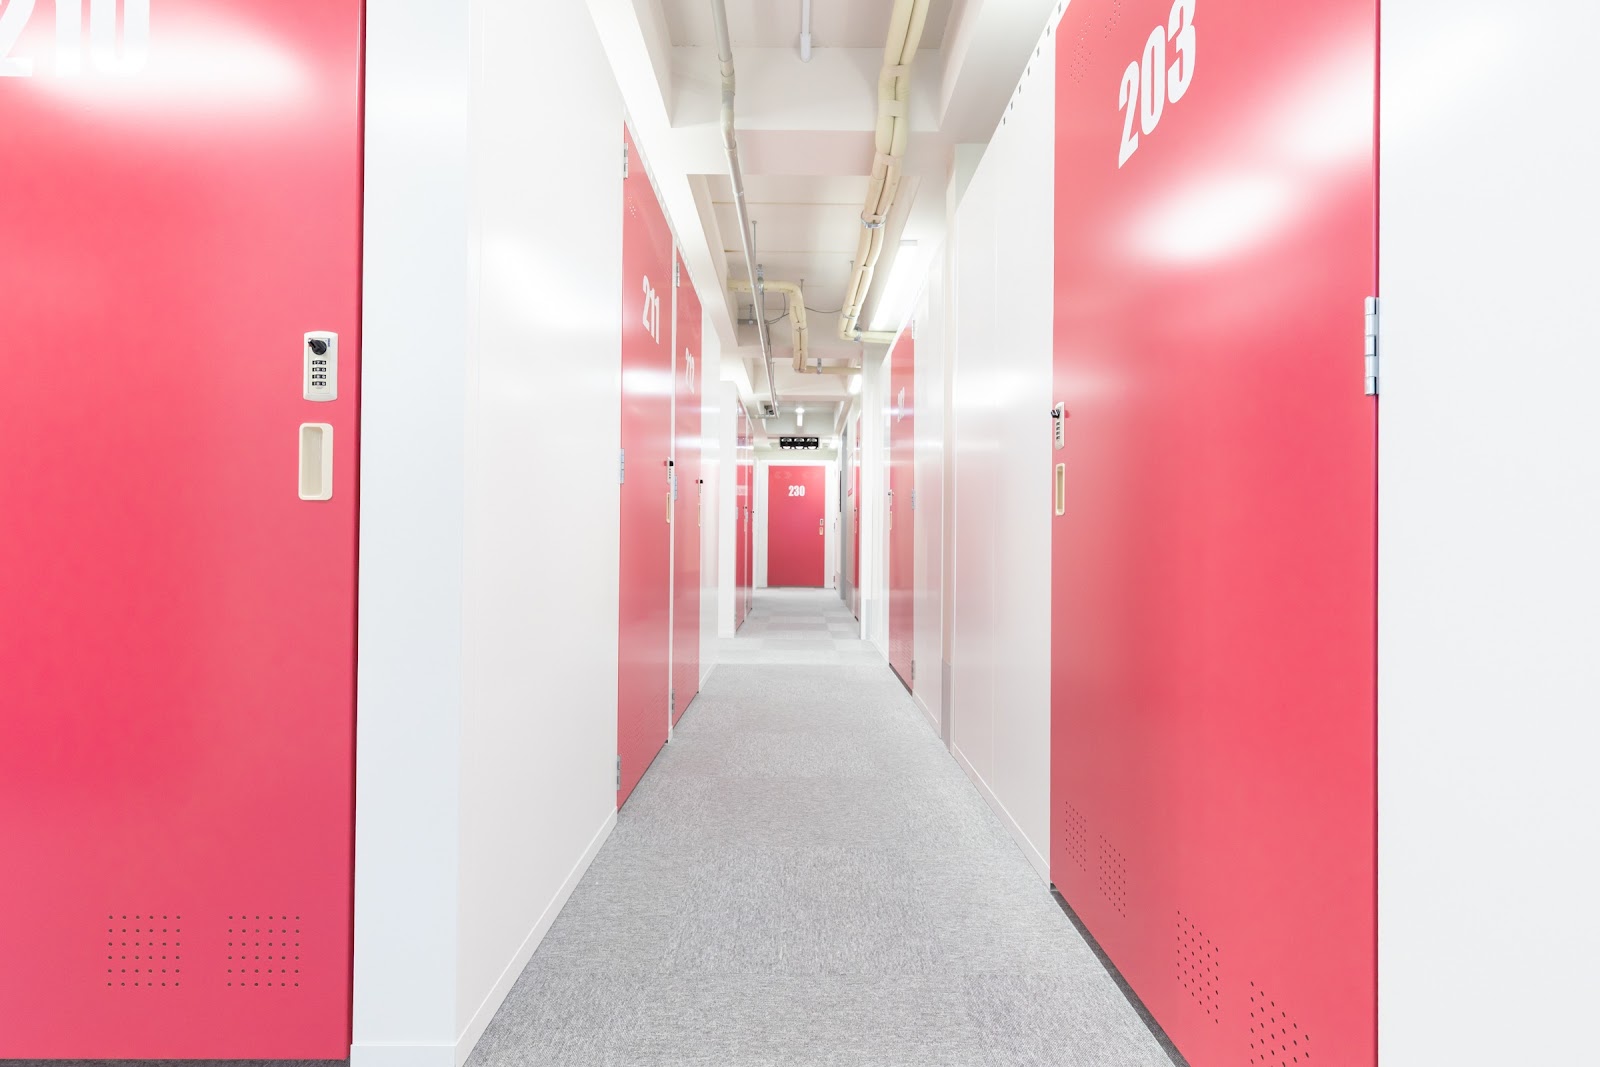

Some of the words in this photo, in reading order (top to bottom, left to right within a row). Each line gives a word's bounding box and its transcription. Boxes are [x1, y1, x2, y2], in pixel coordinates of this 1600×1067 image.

[1118, 0, 1196, 169] 203
[642, 274, 660, 345] 211
[788, 485, 805, 496] 230
